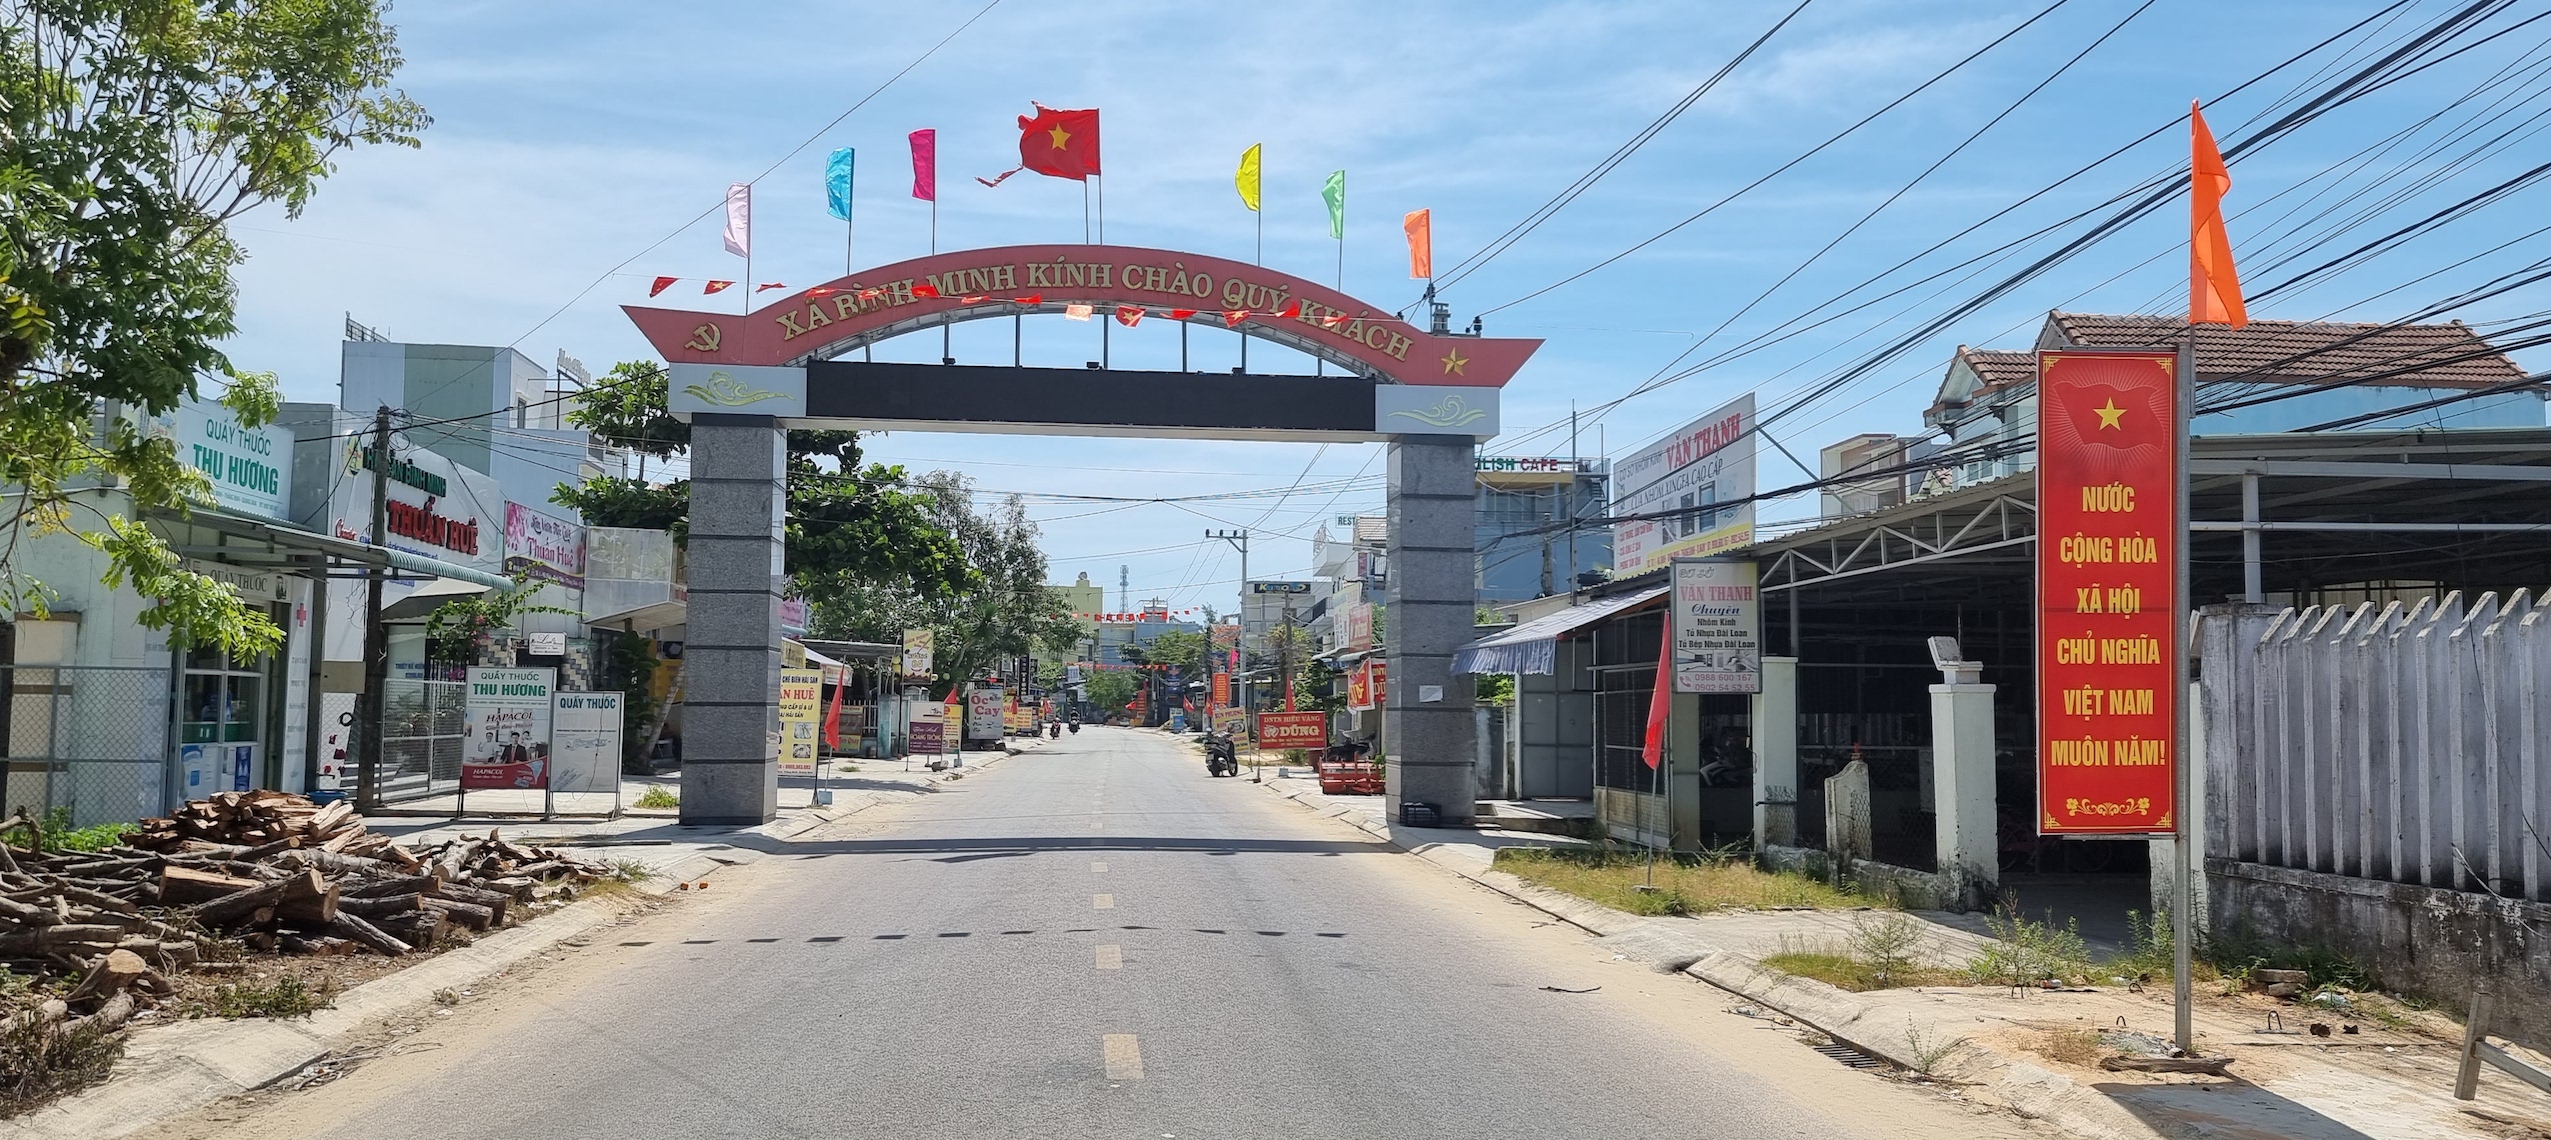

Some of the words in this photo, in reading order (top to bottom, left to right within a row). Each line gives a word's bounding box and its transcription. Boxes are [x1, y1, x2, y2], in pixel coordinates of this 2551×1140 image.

[832, 278, 919, 321] BÌNH
[926, 264, 1018, 297] MINH
[1026, 255, 1113, 289] KÍNH
[1121, 262, 1214, 298] CHÀO
[1221, 277, 1293, 314] QUÝ
[1294, 296, 1414, 362] KHÁCH
[1666, 433, 1691, 471] VĂN
[1694, 412, 1742, 460] THANH
[193, 443, 224, 480] THU
[228, 455, 279, 496] HƯƠNG
[1520, 458, 1558, 471] CAFE
[2082, 481, 2135, 513] NƯỚC
[2060, 531, 2113, 569] CỘNG
[2118, 531, 2158, 563] HÒA
[1680, 583, 1705, 601] VĂN
[1708, 586, 1753, 601] THANH
[2076, 583, 2103, 614] XÃ
[2108, 582, 2141, 620] HỘI
[1691, 603, 1740, 616] Chuyên
[1697, 618, 1719, 627] Nhôm
[1719, 618, 1737, 627] Kính
[1730, 629, 1748, 637] Loan
[1738, 640, 1756, 648] Loan
[2057, 629, 2096, 665] CHỦ
[2101, 633, 2161, 665] NGHĨA
[508, 671, 541, 681] THUỐC
[1695, 674, 1716, 682] 0988
[1718, 674, 1734, 682] 600
[1738, 674, 1752, 682] 167
[473, 683, 498, 695] THU
[501, 683, 547, 697] HƯƠNG
[793, 687, 815, 700] HUÊ
[1695, 683, 1716, 691] 0902
[2063, 683, 2104, 721] VIỆT
[2109, 689, 2154, 715] NAM
[974, 705, 1000, 717] Cay
[2051, 735, 2109, 766] MUÔN
[2114, 735, 2166, 766] NĂM!
